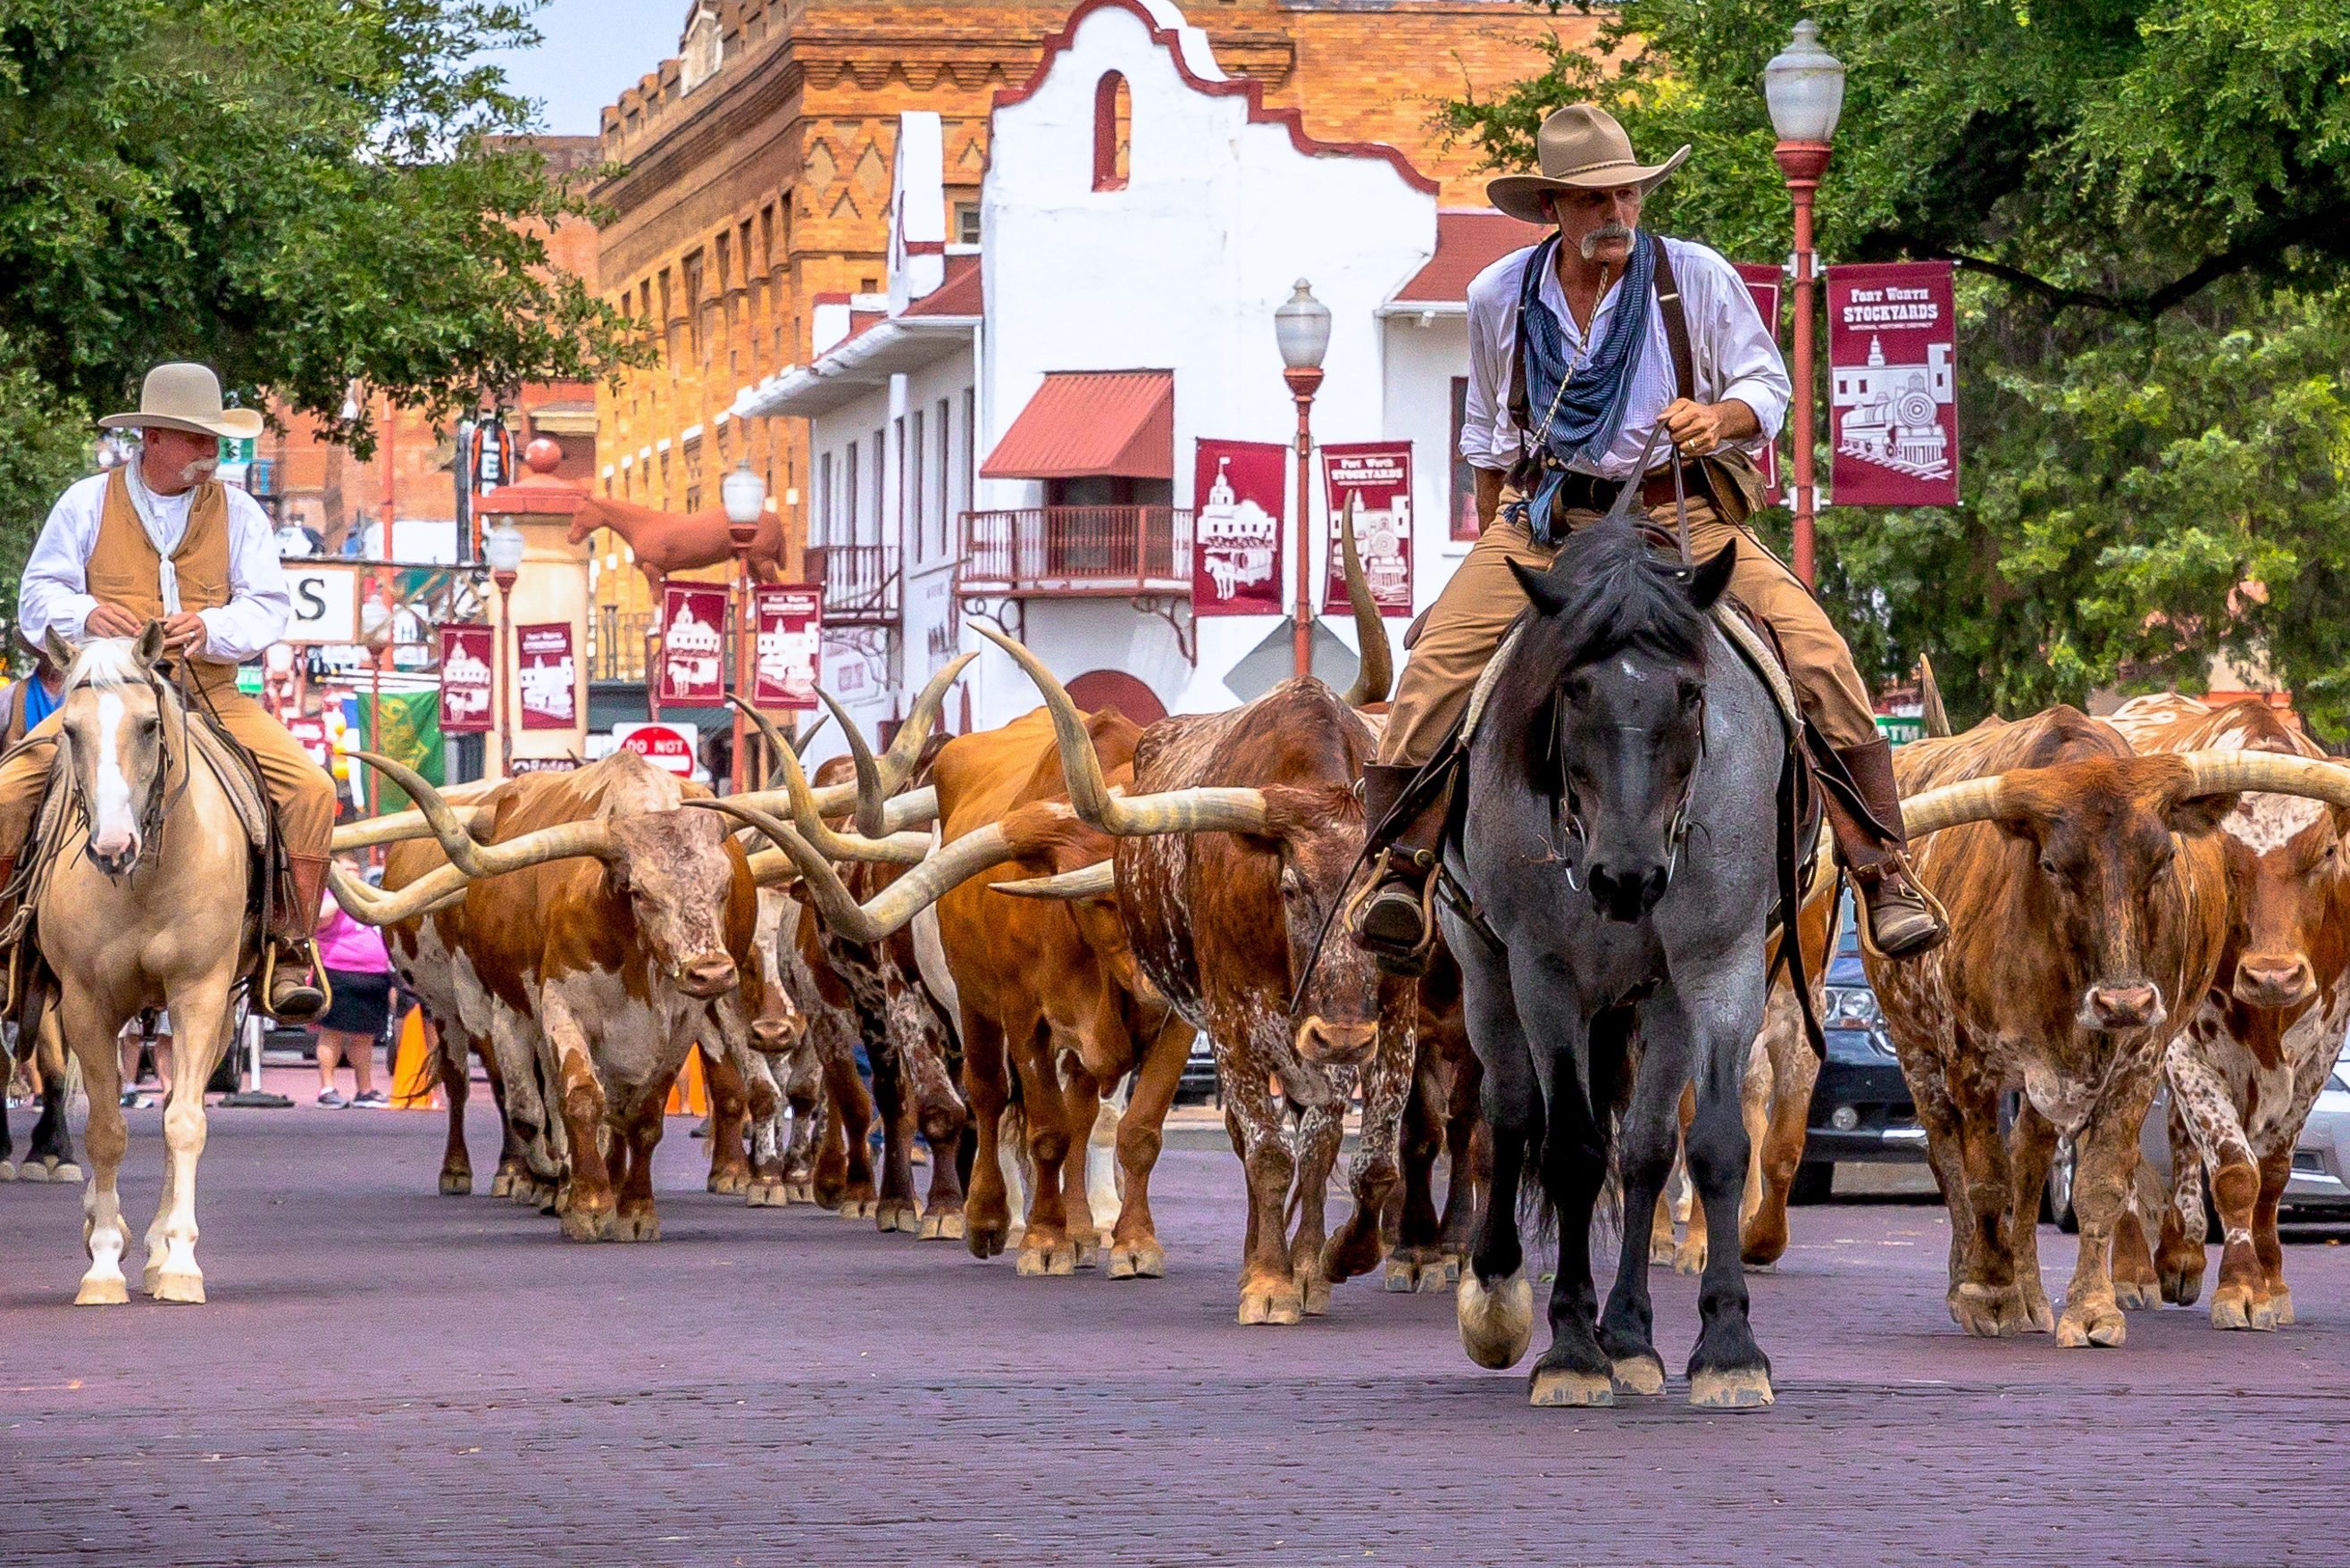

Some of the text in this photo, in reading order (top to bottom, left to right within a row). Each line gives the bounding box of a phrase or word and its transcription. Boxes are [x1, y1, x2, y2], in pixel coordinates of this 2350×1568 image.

[1843, 304, 1938, 322] STOCKYARDS
[626, 738, 683, 754] DO NOT
